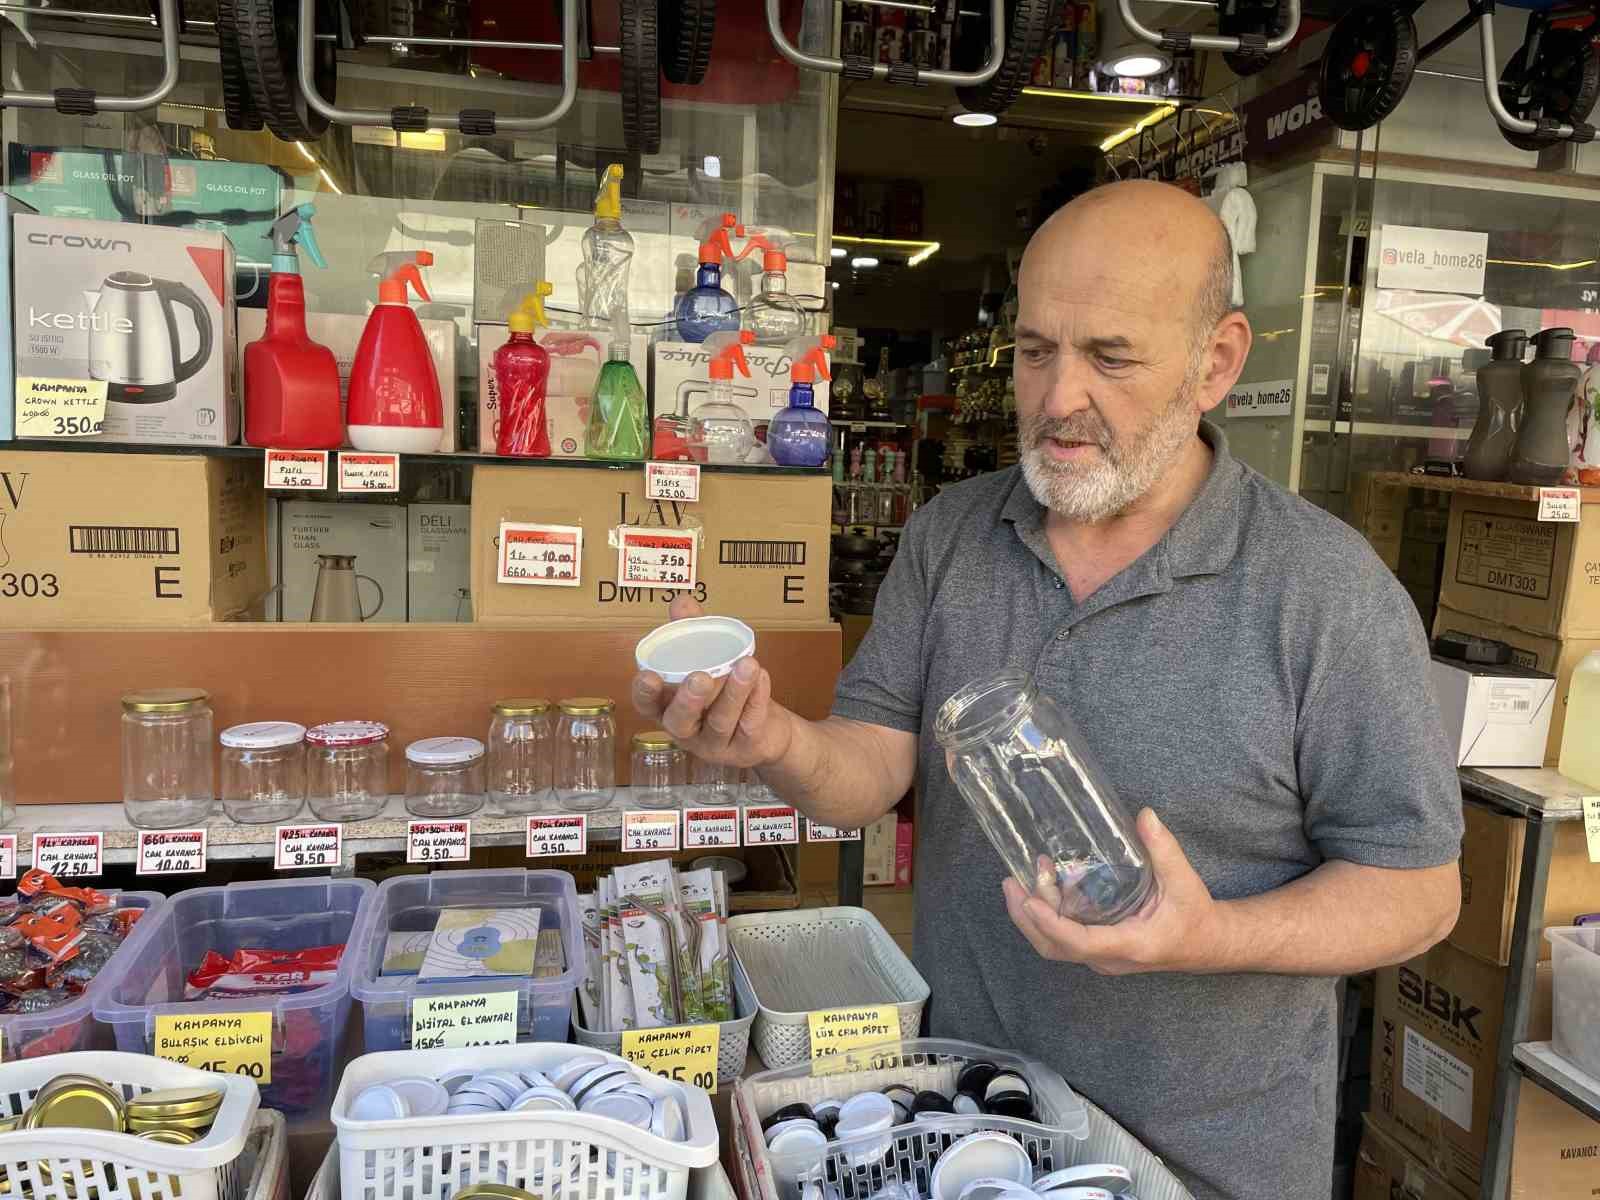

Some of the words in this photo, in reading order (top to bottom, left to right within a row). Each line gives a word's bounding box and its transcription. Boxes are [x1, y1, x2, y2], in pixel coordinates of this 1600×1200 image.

[72, 170, 100, 181] GLASS
[117, 174, 135, 184] POT
[206, 183, 234, 194] GLASS
[234, 185, 249, 195] OIL
[250, 187, 267, 196] POT
[28, 232, 132, 253] crown
[29, 306, 134, 334] kettle
[31, 383, 88, 394] KAMPANYA
[24, 398, 57, 406] CROWN
[63, 398, 99, 406] KETTLE
[420, 514, 452, 527] DELI
[154, 566, 182, 598] E
[1487, 571, 1537, 592] DMT303
[784, 575, 805, 603] E
[429, 998, 487, 1012] KAMPANYA
[1397, 966, 1482, 1044] SBK
[174, 1018, 242, 1031] KAMPANYA
[460, 1016, 473, 1026] EL
[474, 1012, 513, 1025] KANTARI
[824, 1011, 878, 1024] KAMPANYA
[638, 1030, 692, 1044] KAMPANYA
[838, 1027, 858, 1037] CAM
[862, 1024, 889, 1034] PİPET
[161, 1037, 209, 1050] BULAŞIK
[684, 1044, 713, 1056] PİPET
[1560, 1145, 1598, 1161] KAVANOZ
